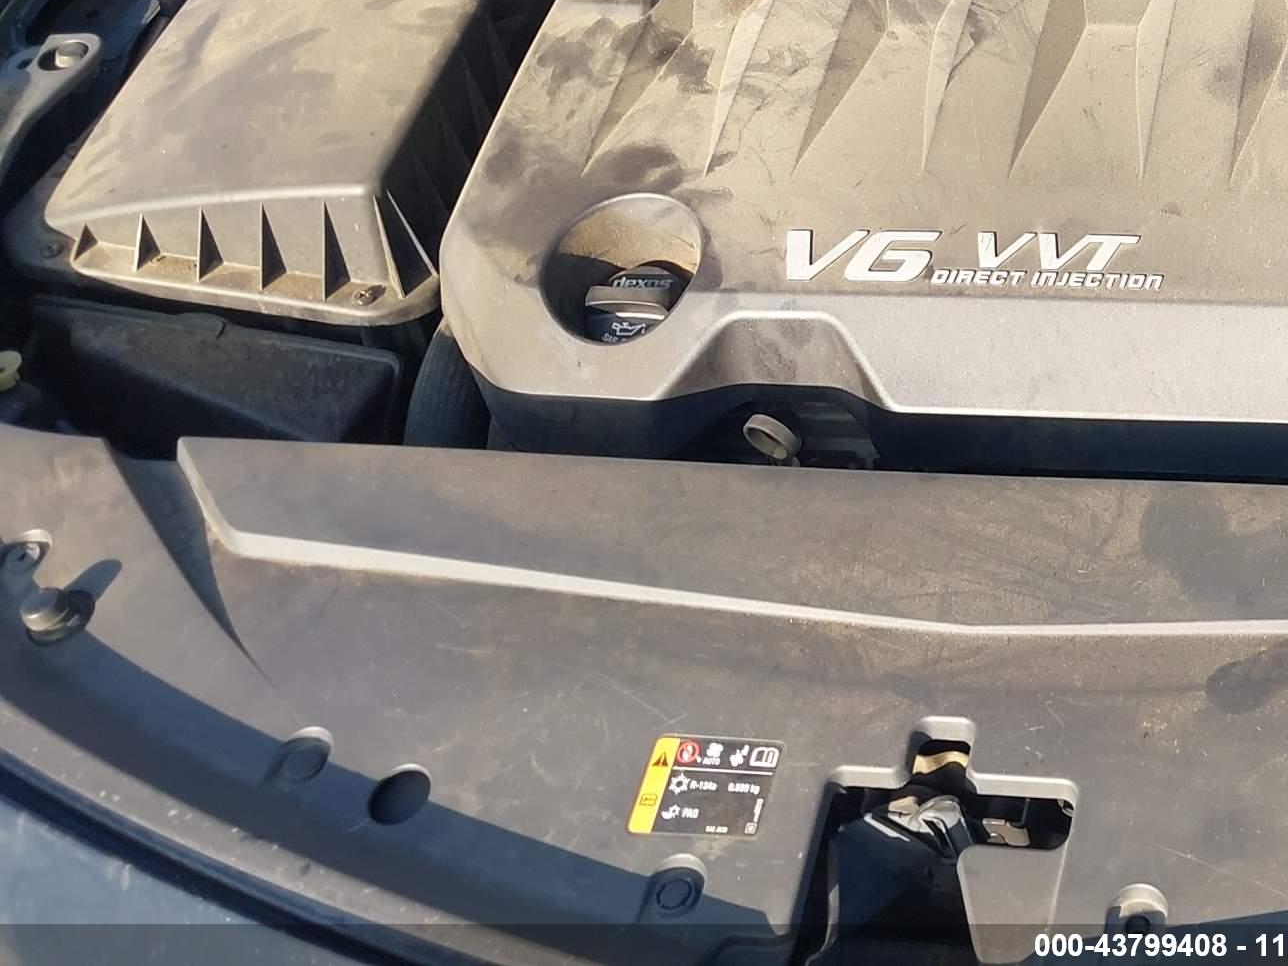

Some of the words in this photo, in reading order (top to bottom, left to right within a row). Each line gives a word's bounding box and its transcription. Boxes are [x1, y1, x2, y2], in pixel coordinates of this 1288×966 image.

[786, 228, 942, 283] V6
[977, 231, 1142, 271] VVT
[612, 276, 673, 290] dexos
[930, 268, 1028, 285] DIRECT
[1031, 270, 1166, 291] INJECTION
